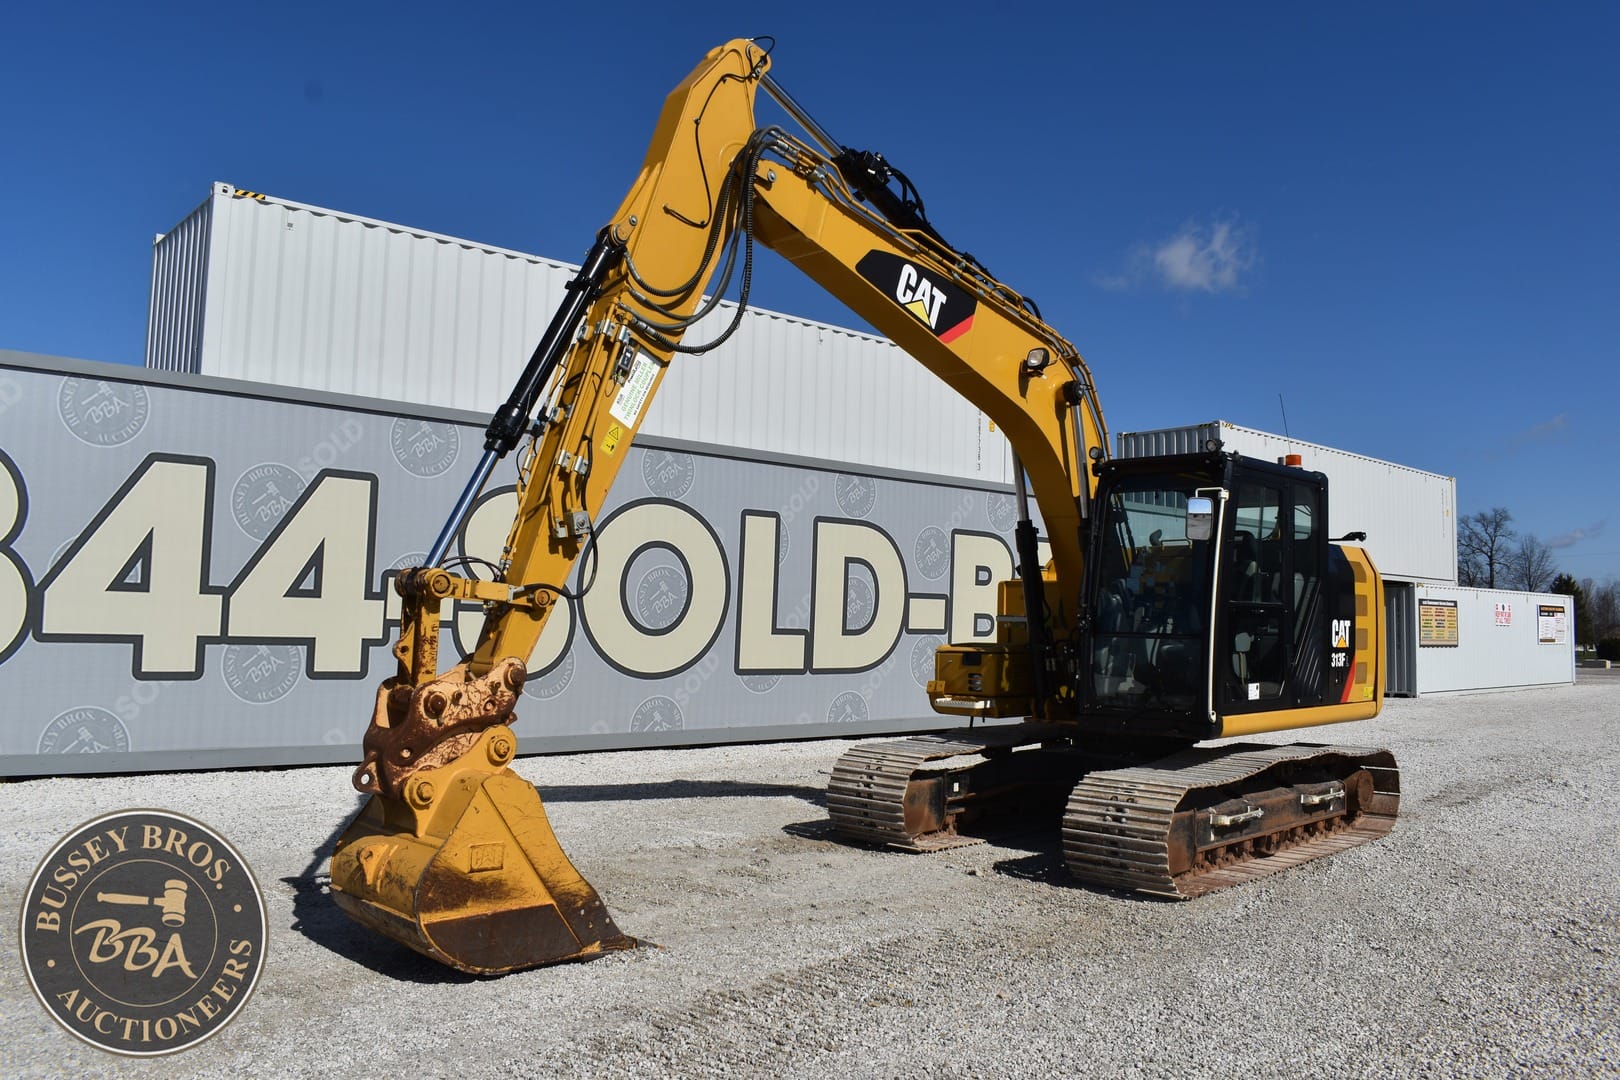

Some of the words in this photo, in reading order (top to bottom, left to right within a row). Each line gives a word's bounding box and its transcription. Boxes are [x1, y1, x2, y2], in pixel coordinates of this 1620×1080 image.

[896, 264, 947, 329] CAT
[84, 396, 130, 424] BBA
[1332, 619, 1351, 648] CAT
[1331, 652, 1346, 668] 313F
